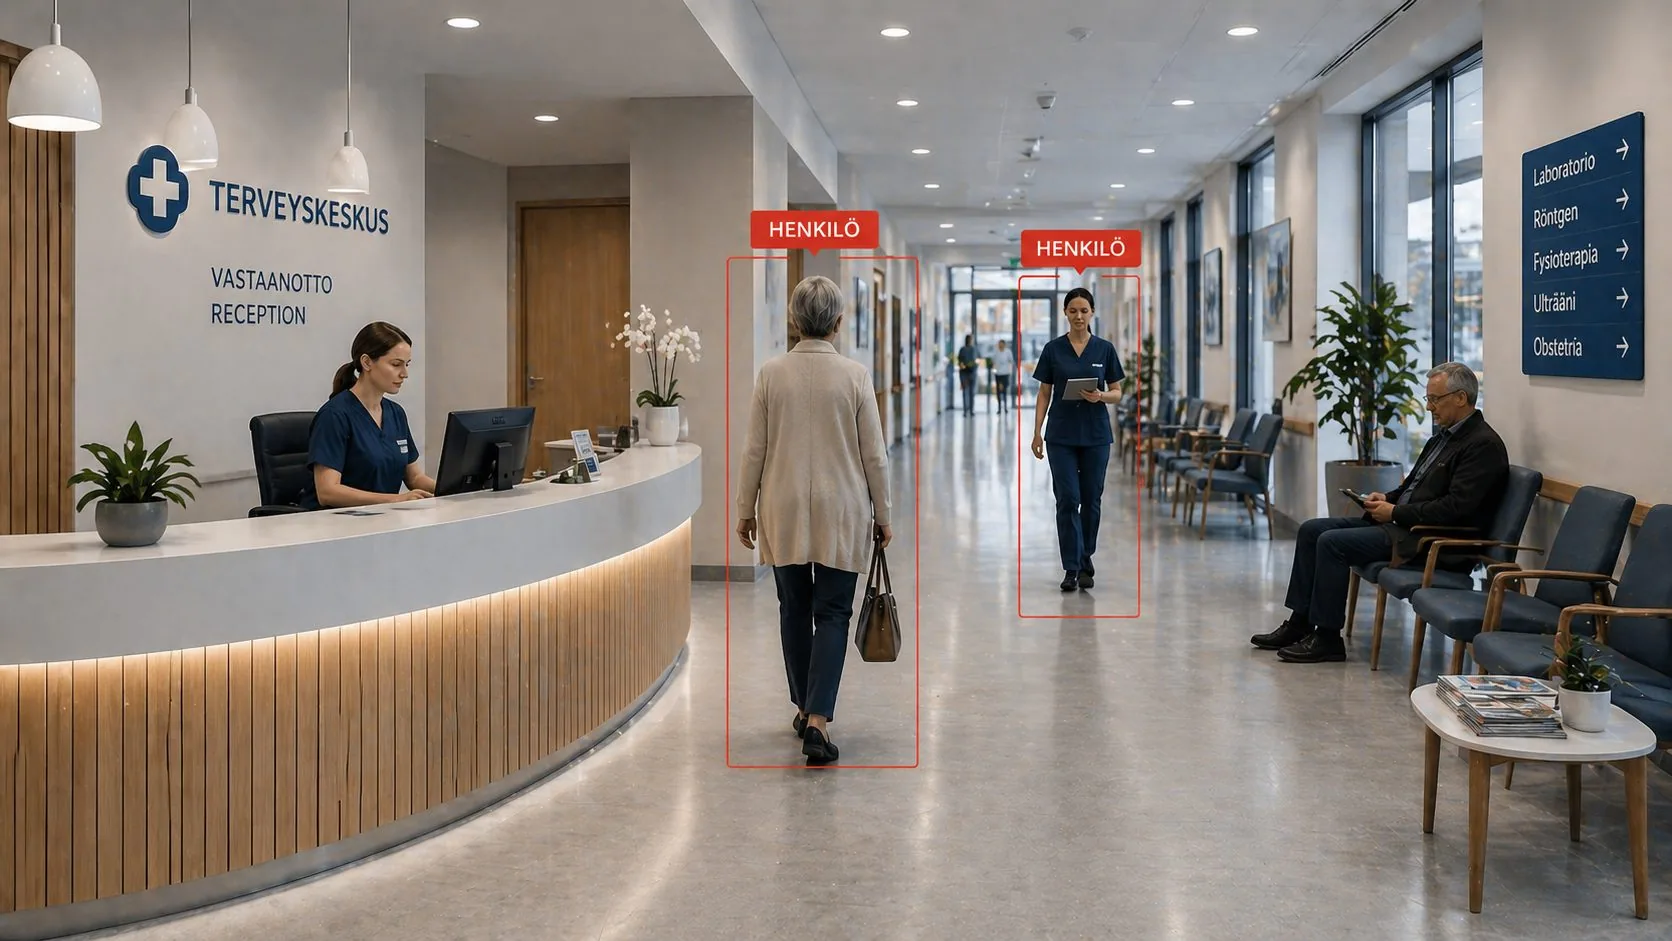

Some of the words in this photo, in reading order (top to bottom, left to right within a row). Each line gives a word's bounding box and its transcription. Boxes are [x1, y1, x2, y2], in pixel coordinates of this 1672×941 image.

[1533, 152, 1595, 186] Laboratorio
[209, 180, 388, 234] TERVEYSKESKUS
[1533, 205, 1578, 229] Röntgen
[1533, 243, 1598, 274] Fysioterapia
[211, 267, 333, 294] VASTAANOTTO
[211, 303, 306, 325] RECEPTION
[1533, 291, 1576, 313] Ulträäni
[1533, 336, 1582, 357] Obstetria
